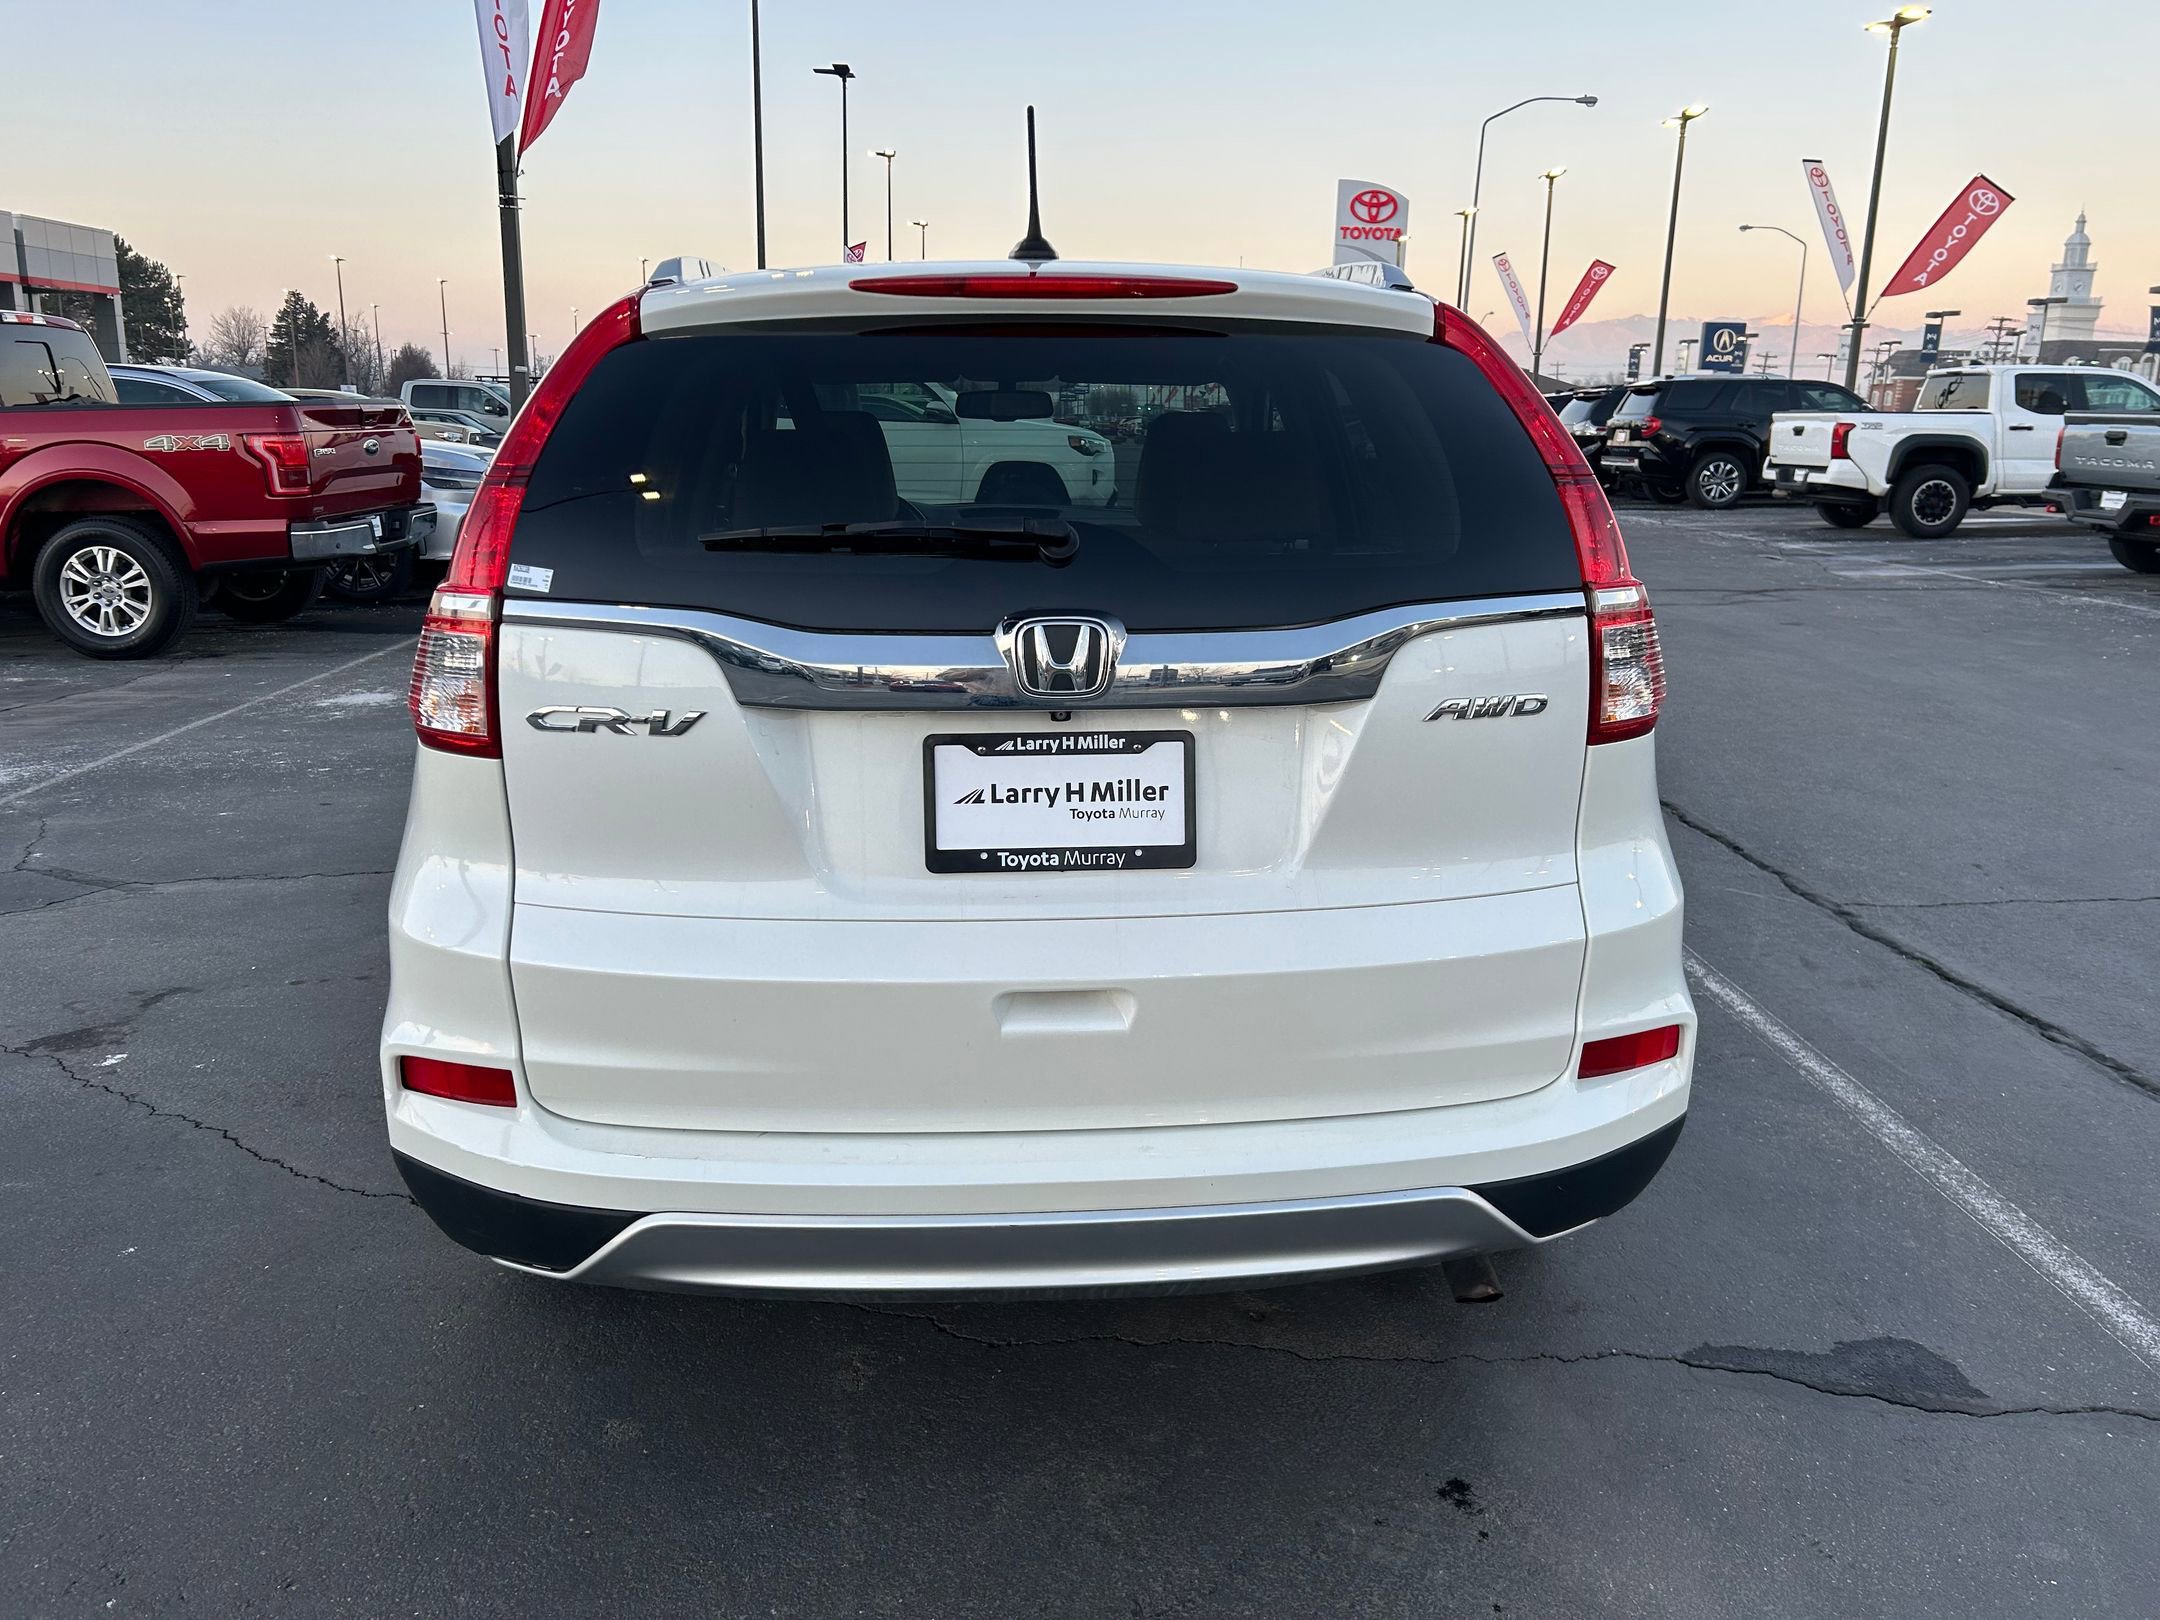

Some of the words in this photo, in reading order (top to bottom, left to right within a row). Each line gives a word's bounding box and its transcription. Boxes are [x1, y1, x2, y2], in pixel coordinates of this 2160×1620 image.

[1340, 226, 1402, 241] TOYOTA
[1821, 190, 1855, 266] TOYOTA
[1913, 212, 1977, 286] TOYOTA
[1563, 281, 1596, 326] TOYOTA
[1705, 354, 1734, 363] ACUR
[2074, 455, 2156, 470] TACOMA
[1422, 692, 1549, 722] AWD
[525, 705, 709, 737] CR-V
[1017, 737, 1060, 753] Larry
[1062, 737, 1075, 750] H
[1077, 734, 1126, 750] Miller
[990, 783, 1060, 808] Larry
[1066, 782, 1084, 803] H
[1091, 779, 1169, 803] Miller
[1069, 808, 1115, 823] Toyota
[1119, 807, 1165, 821] Murray
[997, 851, 1060, 871] Toyota
[1063, 850, 1126, 868] Murray
